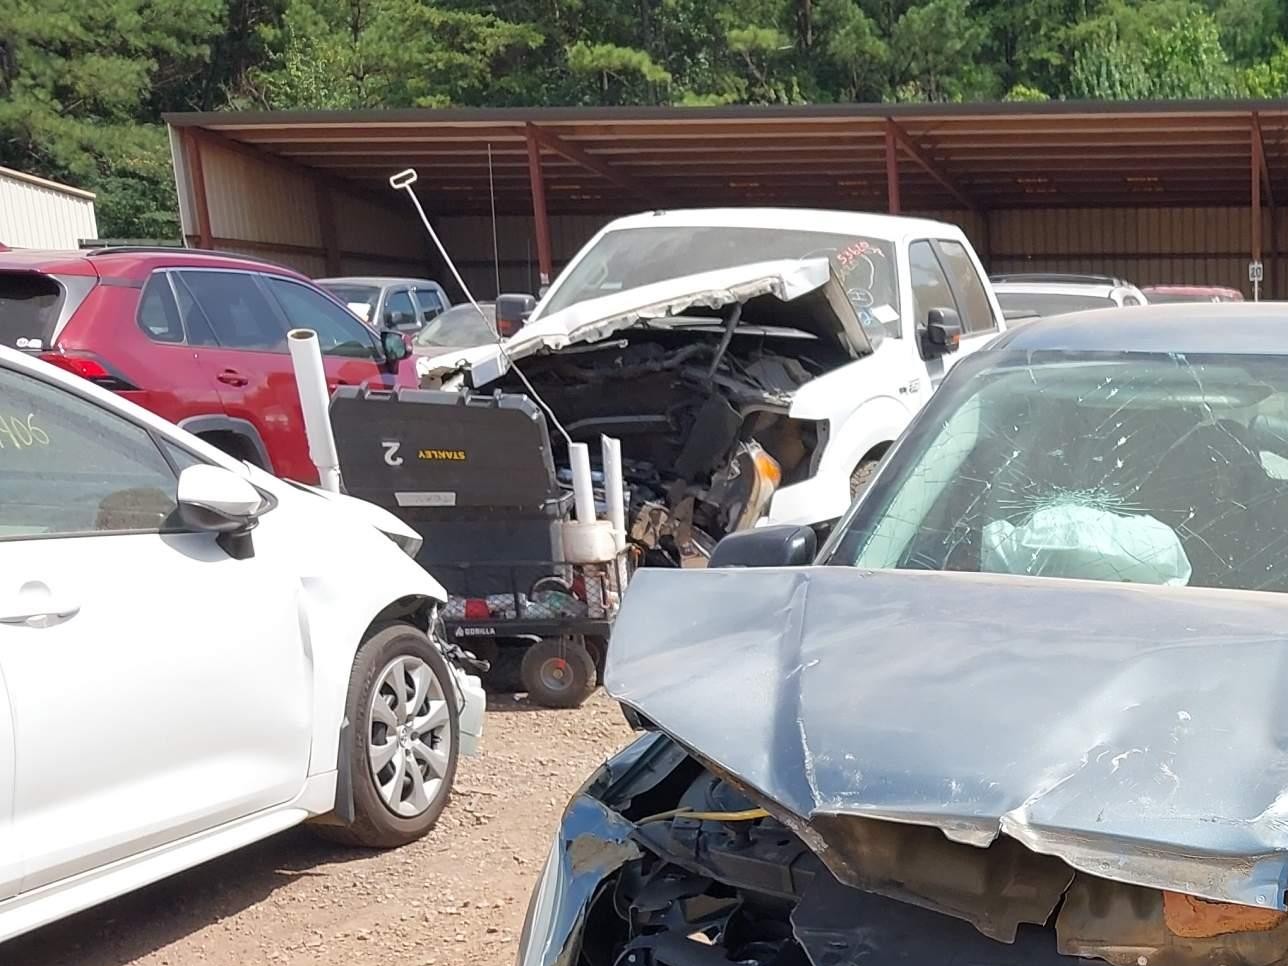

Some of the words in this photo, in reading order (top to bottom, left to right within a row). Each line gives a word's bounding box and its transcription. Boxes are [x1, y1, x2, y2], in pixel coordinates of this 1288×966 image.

[381, 441, 404, 466] 2
[418, 450, 466, 460] STANLEY
[464, 627, 496, 636] GORILLA
